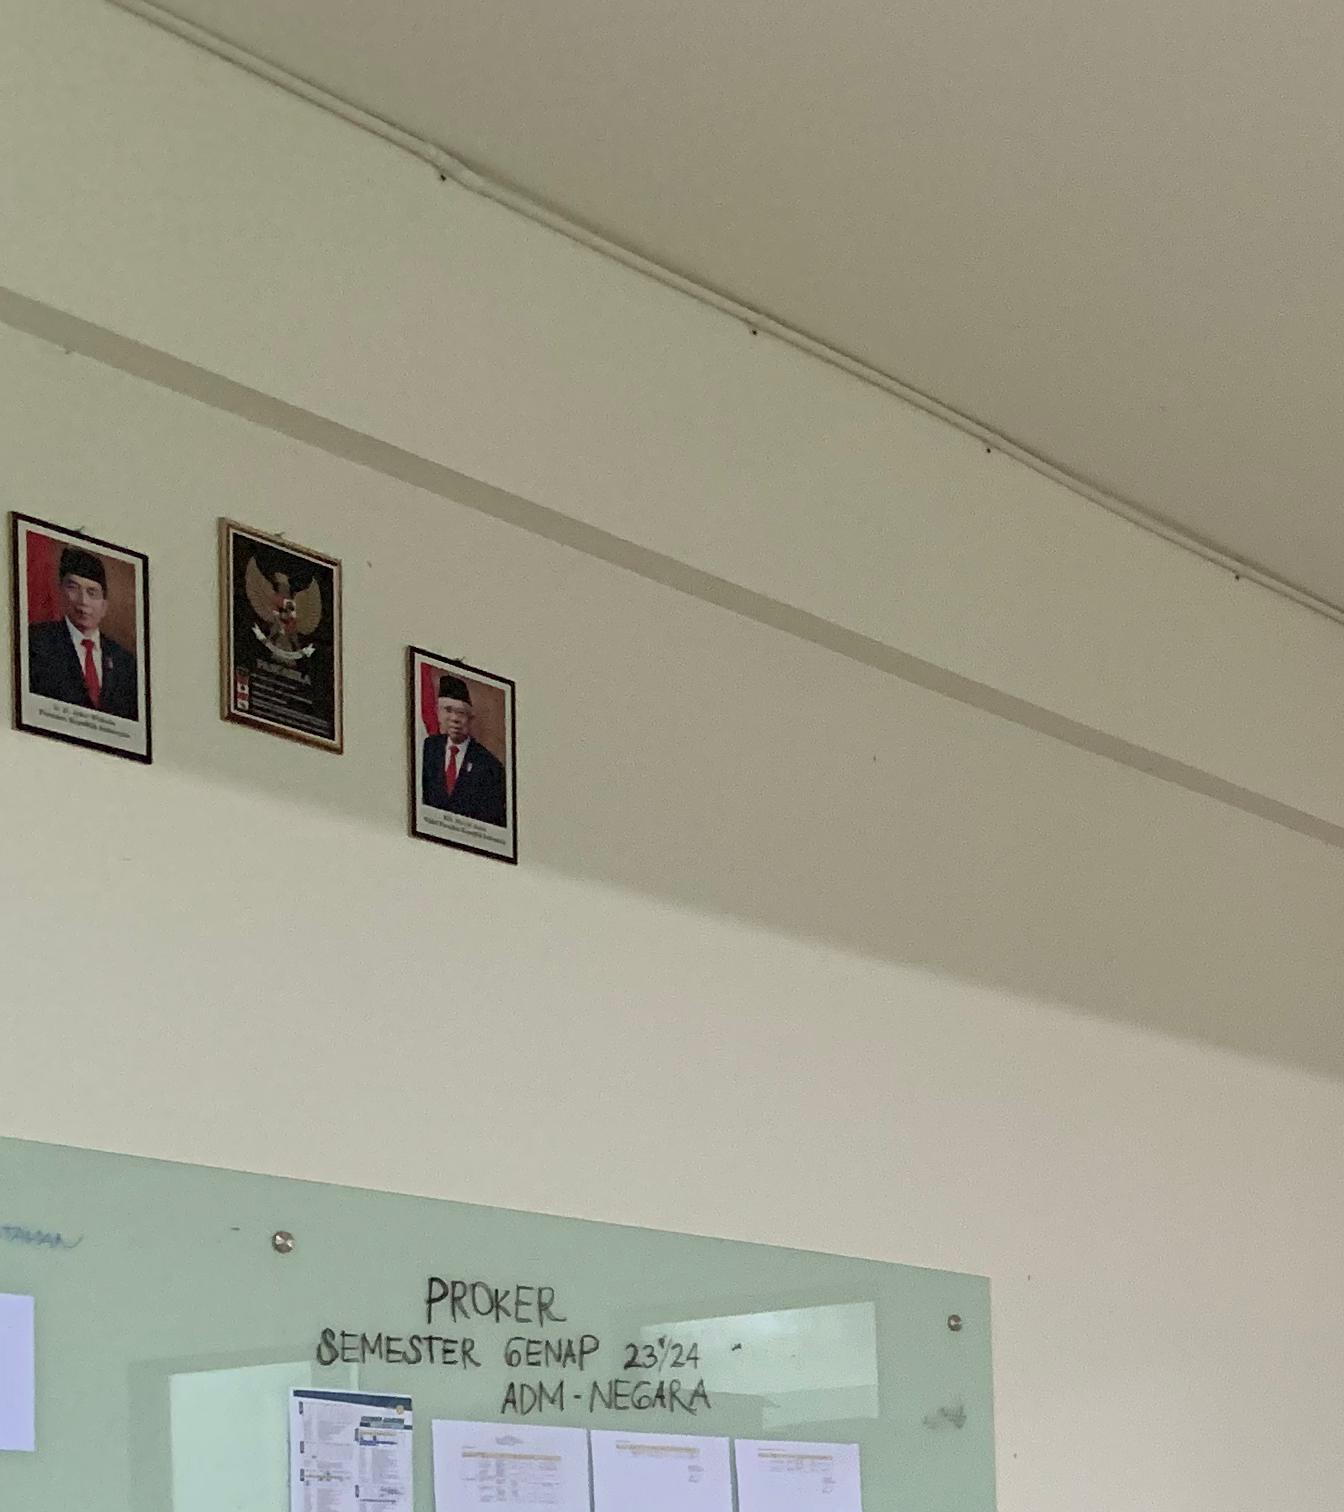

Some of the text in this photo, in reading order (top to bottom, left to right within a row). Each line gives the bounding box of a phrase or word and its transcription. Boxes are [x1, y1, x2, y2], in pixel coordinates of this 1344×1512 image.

[425, 1276, 567, 1324] PROKER
[316, 1328, 481, 1369] SEMESTER
[504, 1334, 600, 1371] GENAP
